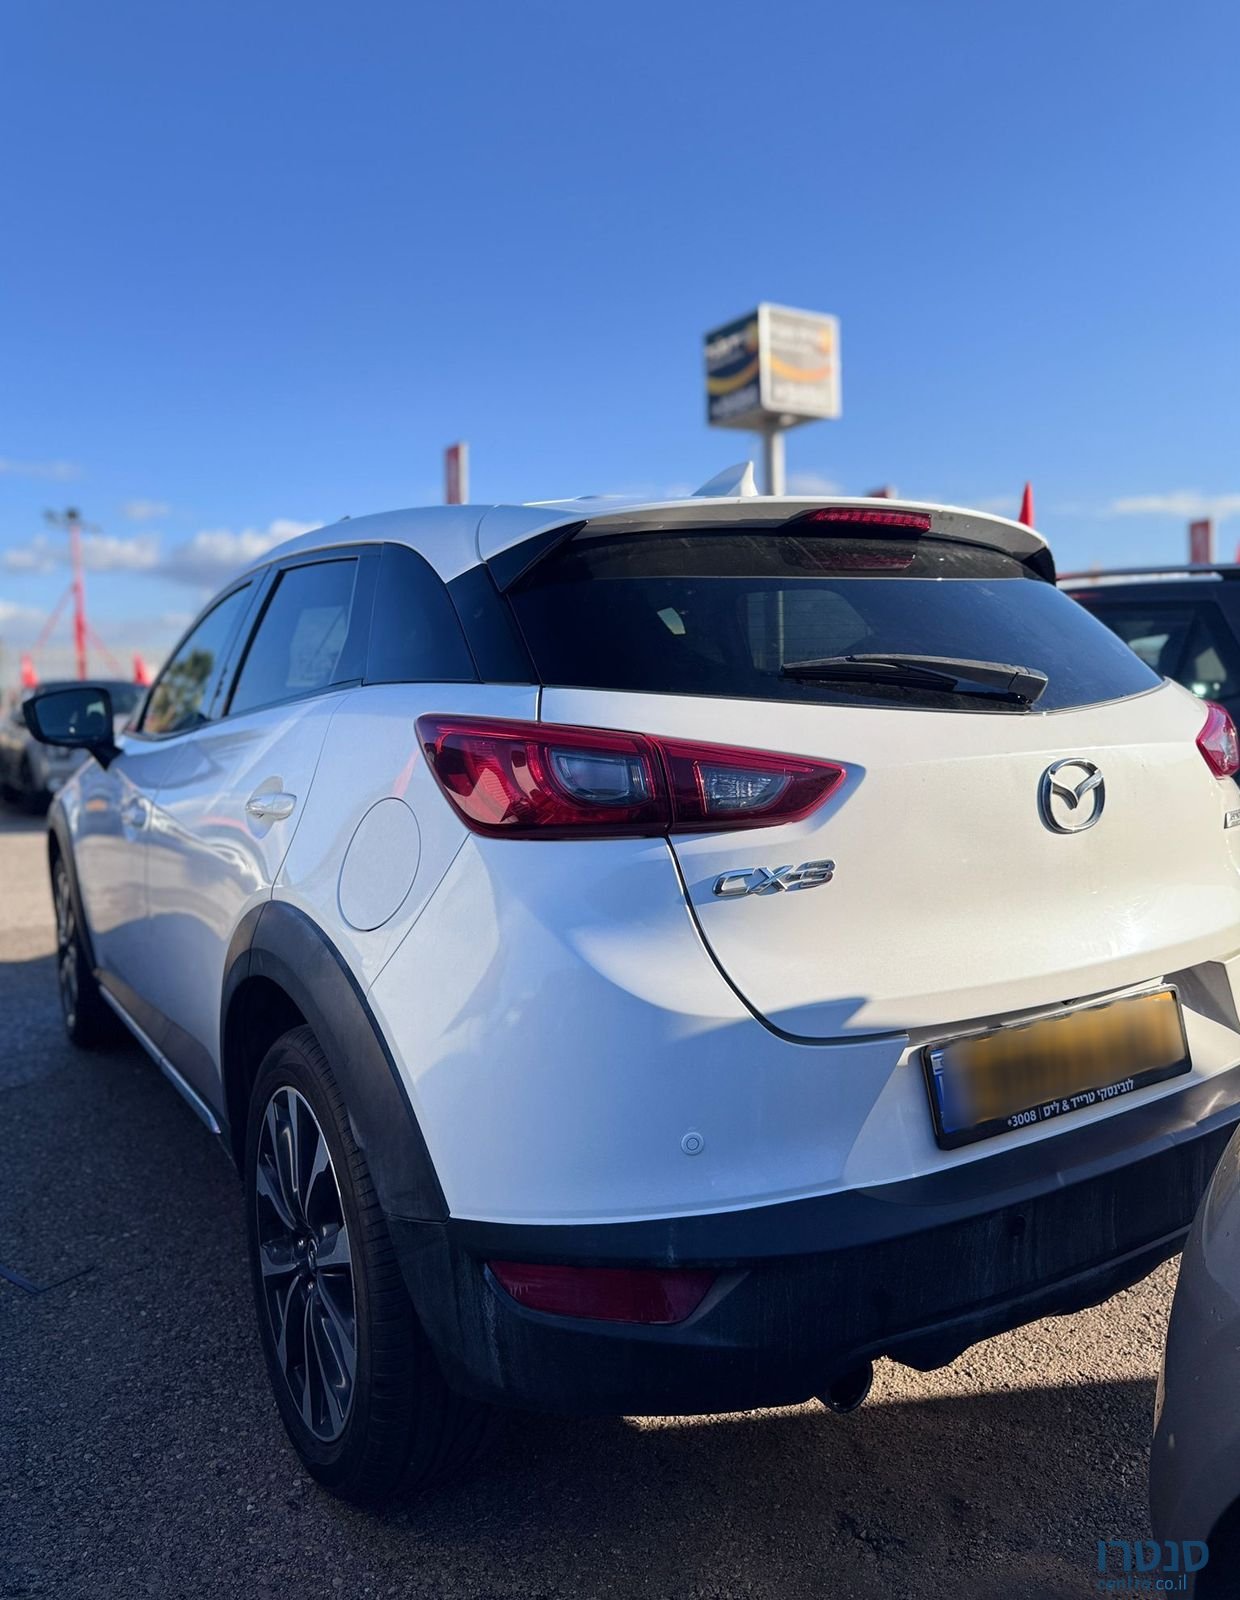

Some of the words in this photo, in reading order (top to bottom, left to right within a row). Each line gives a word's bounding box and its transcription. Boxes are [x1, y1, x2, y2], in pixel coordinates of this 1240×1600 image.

[712, 859, 836, 897] CX-3
[1070, 1091, 1096, 1108] טרייד
[1096, 1078, 1134, 1101] לובינסקי
[1062, 1099, 1070, 1111] &
